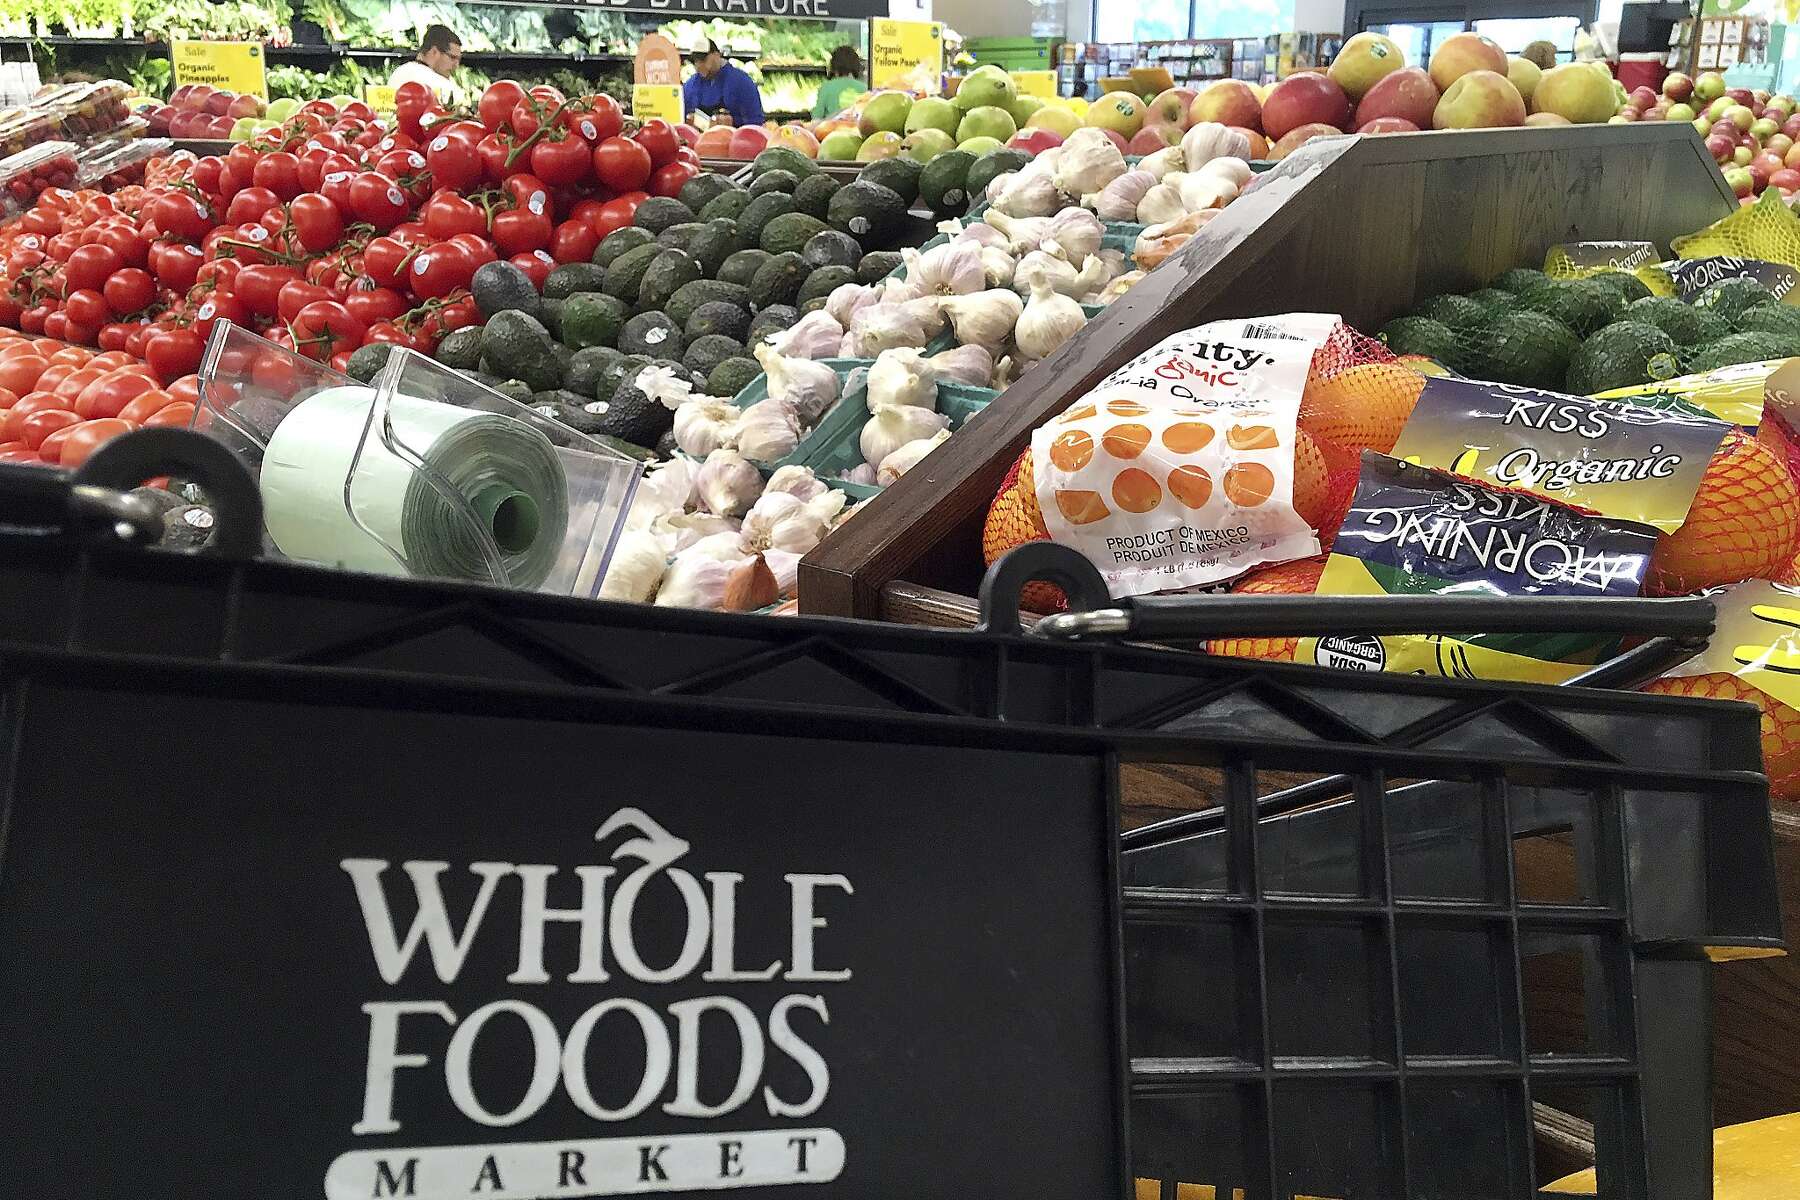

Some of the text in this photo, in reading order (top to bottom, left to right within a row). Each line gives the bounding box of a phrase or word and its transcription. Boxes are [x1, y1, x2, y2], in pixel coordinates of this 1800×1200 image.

[184, 46, 206, 56] Sale
[874, 43, 902, 56] Organic
[178, 63, 216, 72] Organic
[180, 74, 229, 83] Pineapples
[1608, 244, 1652, 272] Organic
[1503, 399, 1609, 438] KISS
[1496, 445, 1681, 490] Organic
[1106, 526, 1248, 550] PRODUCT OF MEXICO
[1114, 536, 1250, 564] PRODUIT DE MEXICO
[1328, 637, 1376, 659] ORGANIC
[339, 858, 855, 985] WHOLE
[351, 994, 831, 1136] FOODS
[373, 1136, 818, 1199] MARKET
